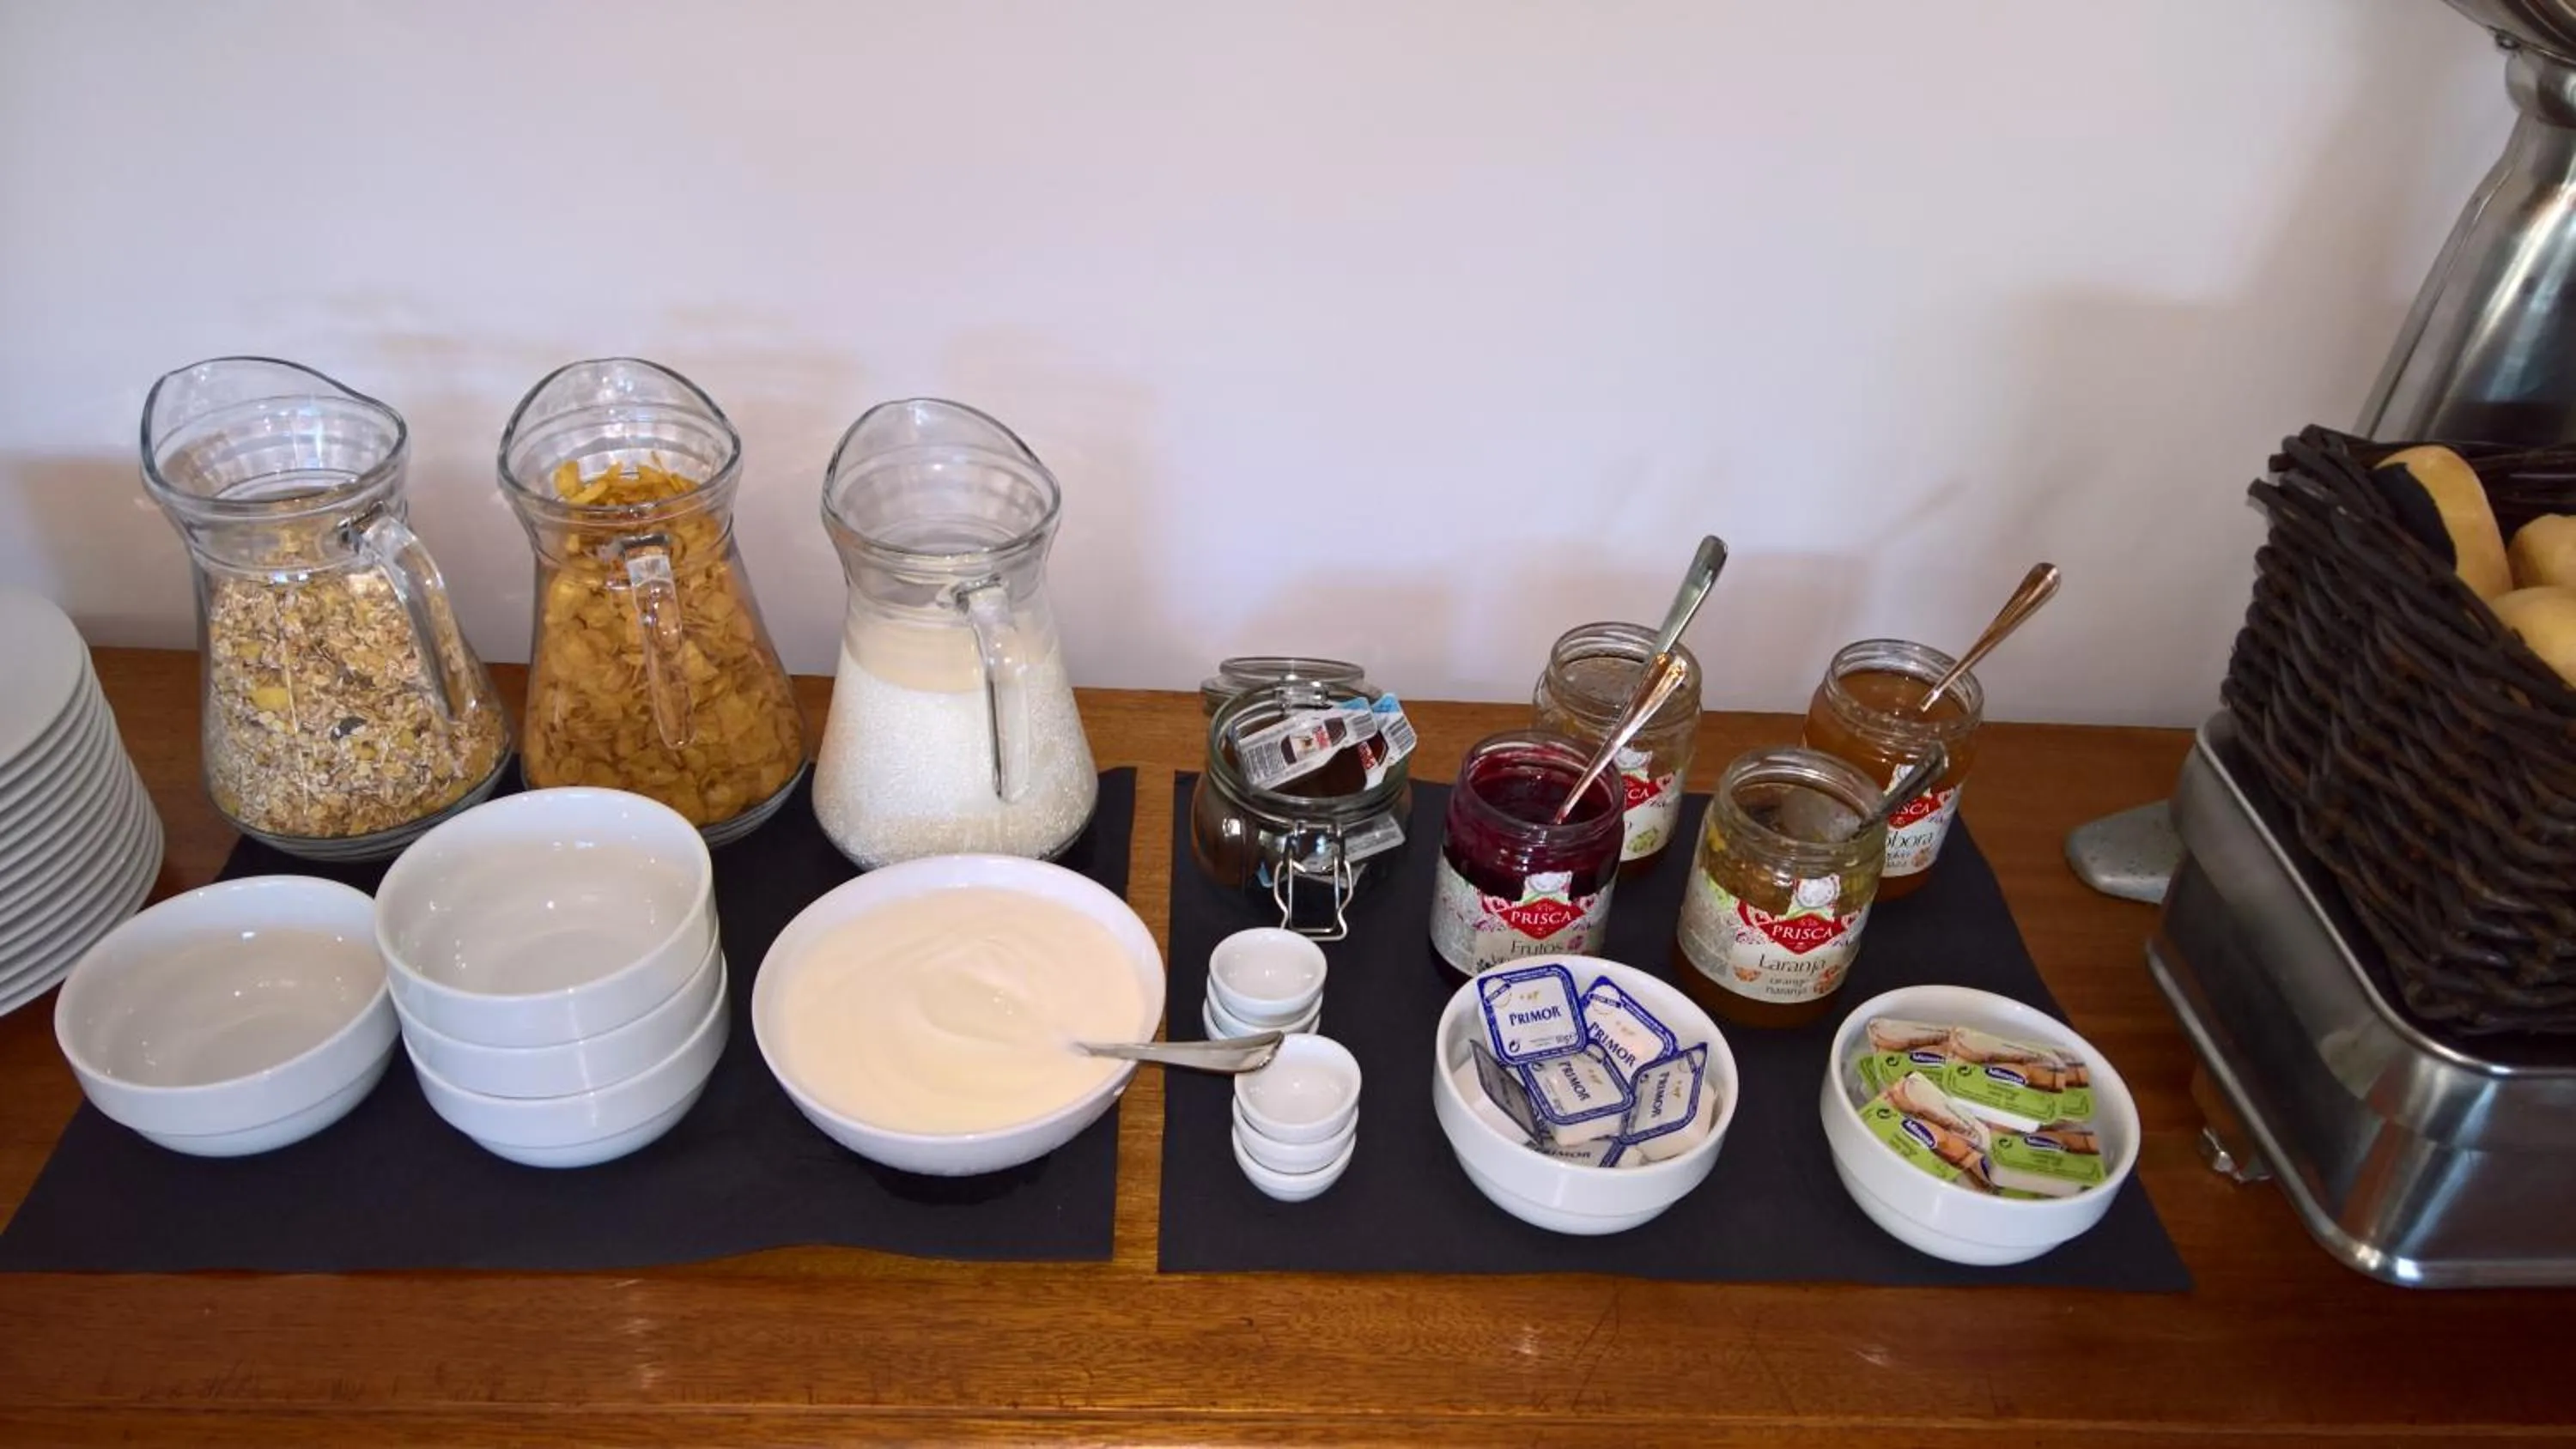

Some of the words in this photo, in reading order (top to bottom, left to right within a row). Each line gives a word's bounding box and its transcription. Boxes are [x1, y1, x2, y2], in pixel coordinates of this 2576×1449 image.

[1510, 911, 1571, 925] PRISCA
[1771, 925, 1833, 941] PRISCA
[1510, 939, 1564, 955] Frutos
[1759, 954, 1827, 976] Laranja
[1509, 1005, 1563, 1027] PRIMOR
[1588, 1021, 1637, 1068] PRIMOR
[1558, 1060, 1591, 1101] PRIMOR
[1650, 1071, 1671, 1119] PRIMOR
